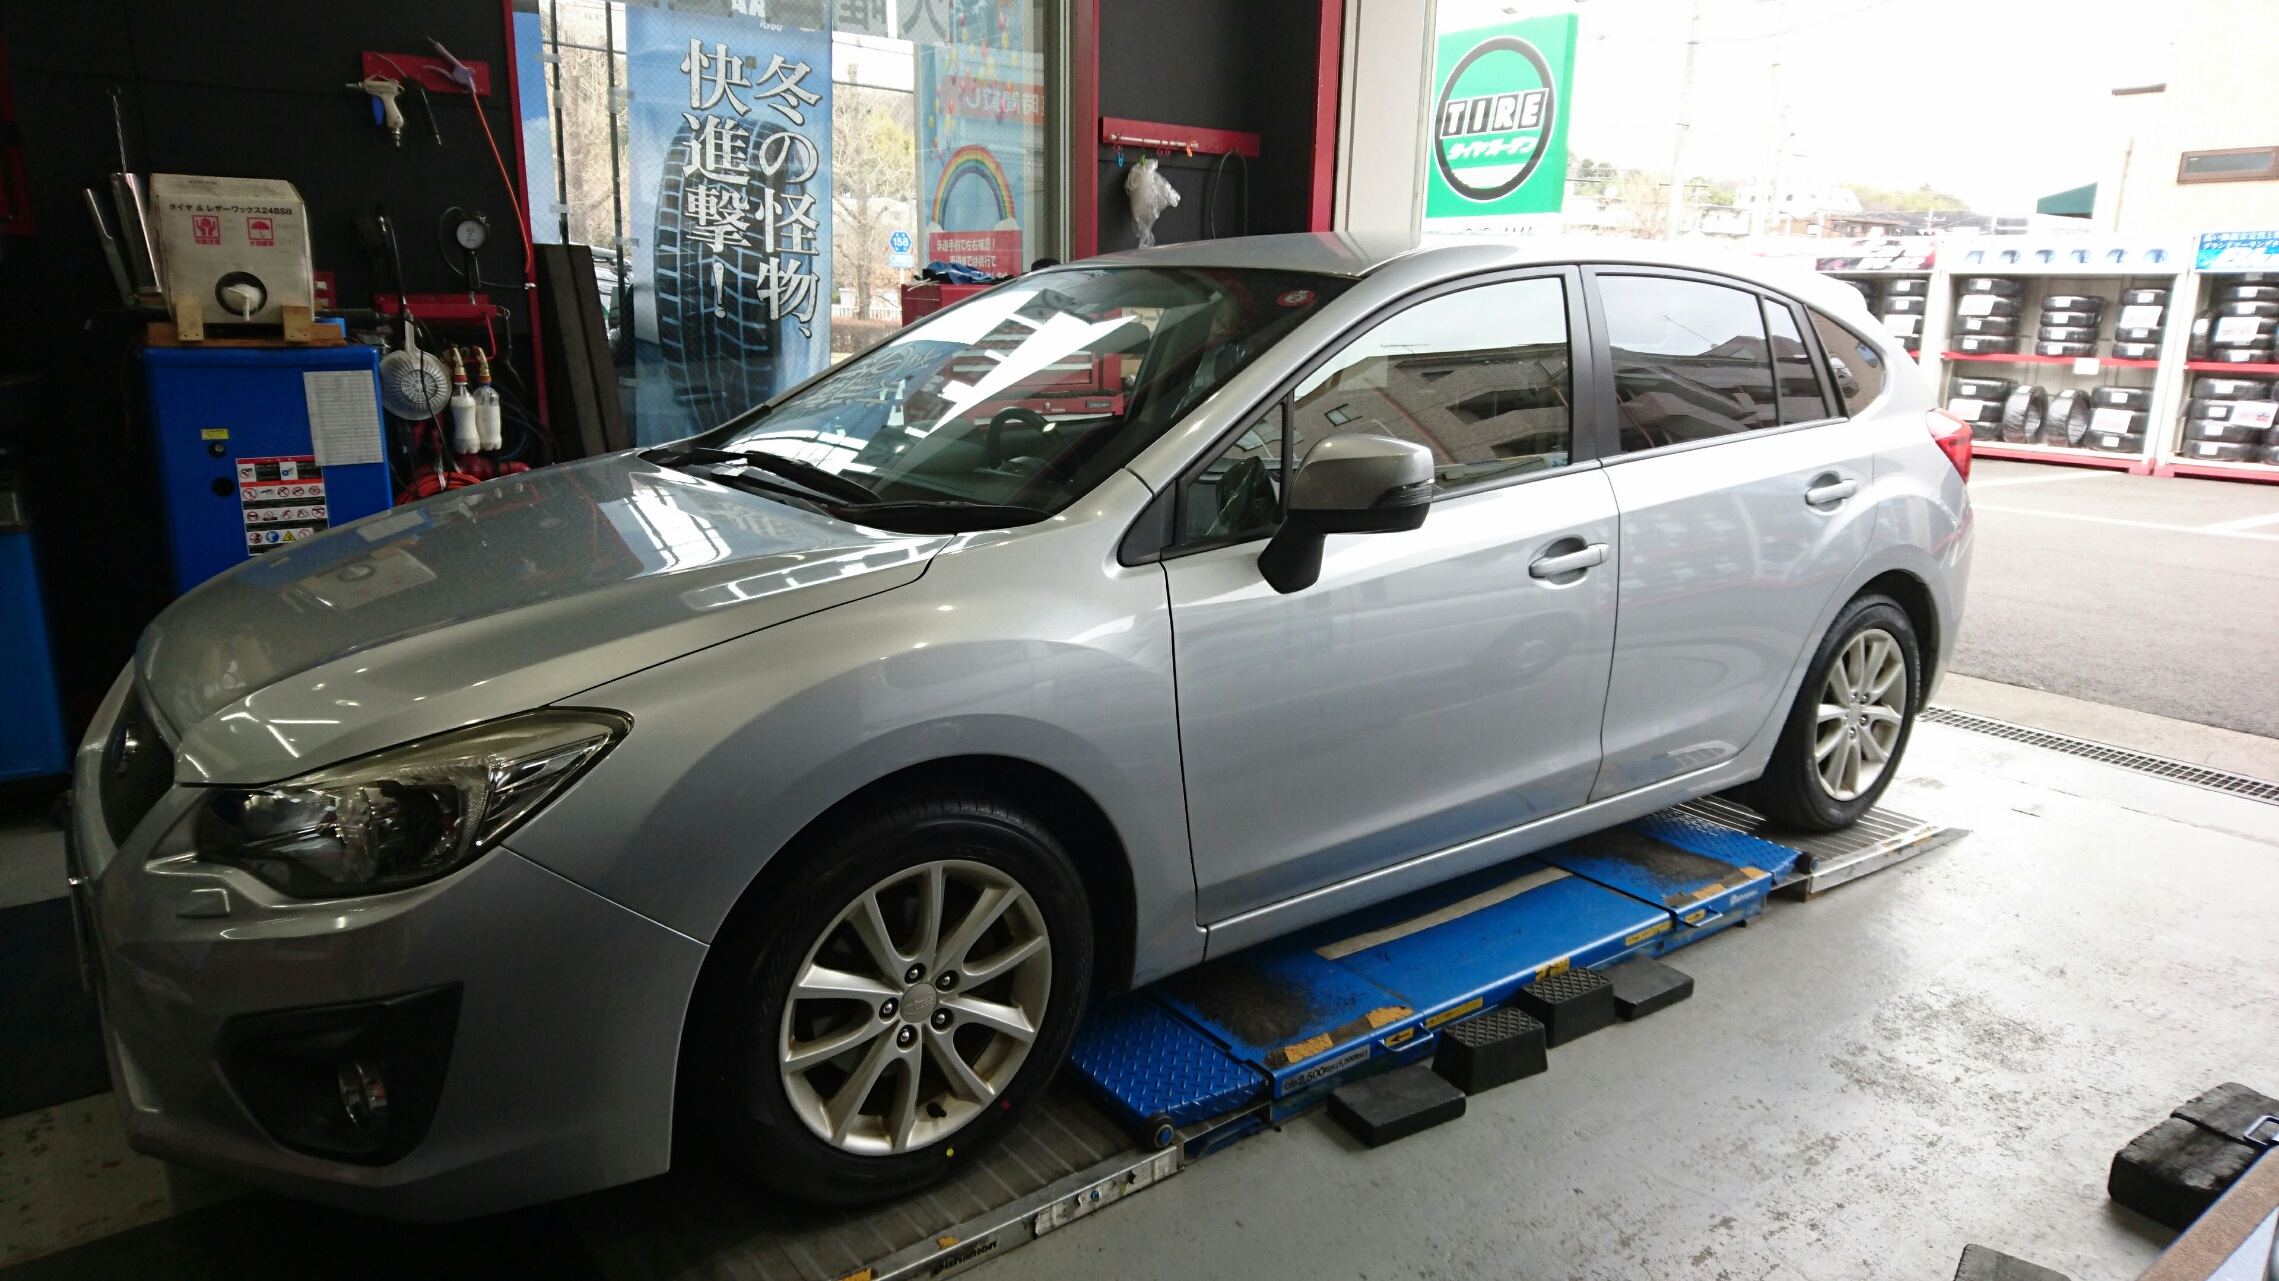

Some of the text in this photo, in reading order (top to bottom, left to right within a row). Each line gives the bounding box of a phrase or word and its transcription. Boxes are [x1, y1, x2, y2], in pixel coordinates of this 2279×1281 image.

[1447, 92, 1543, 135] TIRE
[1446, 135, 1540, 160] タイヤガーデン
[680, 37, 752, 319] 快進撃！
[169, 203, 193, 212] タイヤ
[755, 53, 823, 339] 冬の怪物、
[892, 237, 909, 247] 158
